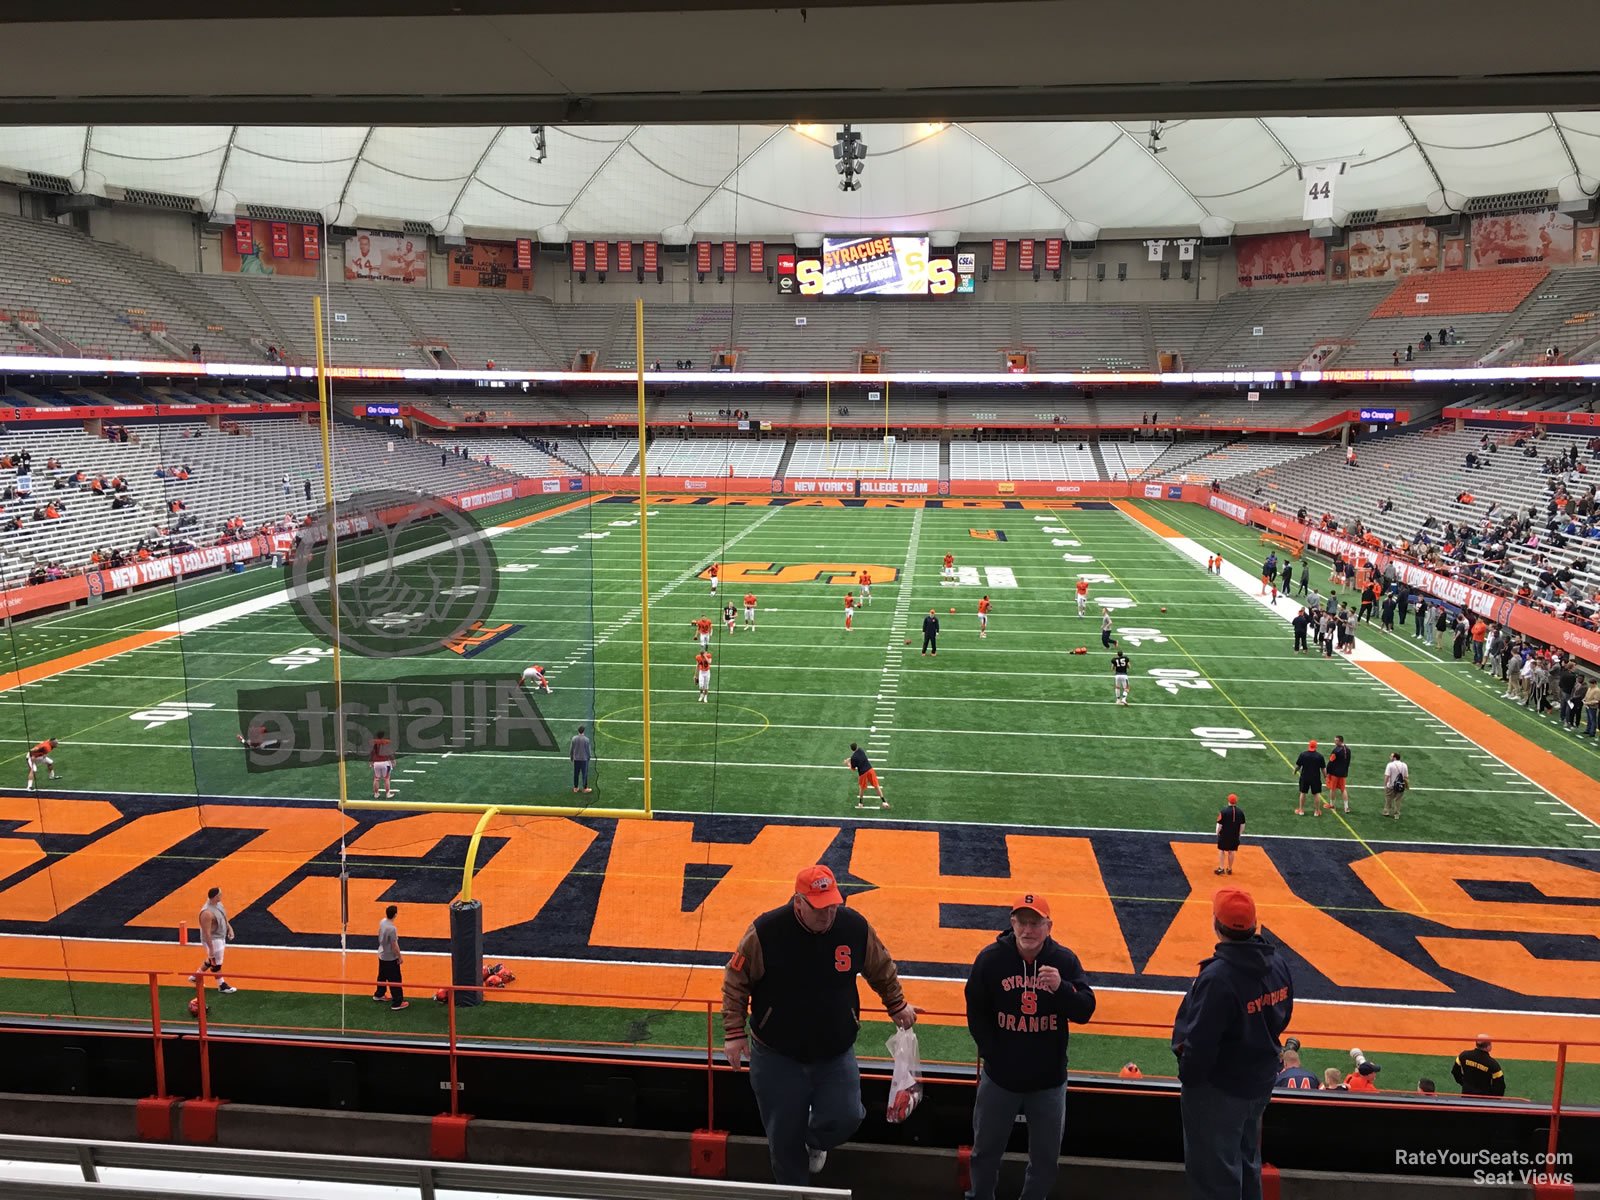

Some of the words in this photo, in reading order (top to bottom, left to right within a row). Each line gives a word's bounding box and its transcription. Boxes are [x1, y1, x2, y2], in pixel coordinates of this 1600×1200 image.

[1309, 181, 1330, 200] 44
[823, 238, 891, 268] SYRACUSE
[796, 259, 824, 294] S
[928, 258, 956, 294] S
[794, 481, 816, 492] NEW
[818, 481, 854, 493] YORK'S
[901, 483, 928, 493] TEAM
[110, 564, 138, 589] NEW
[139, 558, 182, 583] YORK'S
[183, 549, 226, 576] COLLEGE
[1432, 576, 1470, 606] COLLEGE
[1468, 588, 1496, 617] TEAM
[1116, 658, 1126, 667] 15
[1025, 895, 1034, 904] S
[835, 945, 851, 972] S
[1021, 991, 1038, 1015] S
[997, 1011, 1058, 1033] ORANGE
